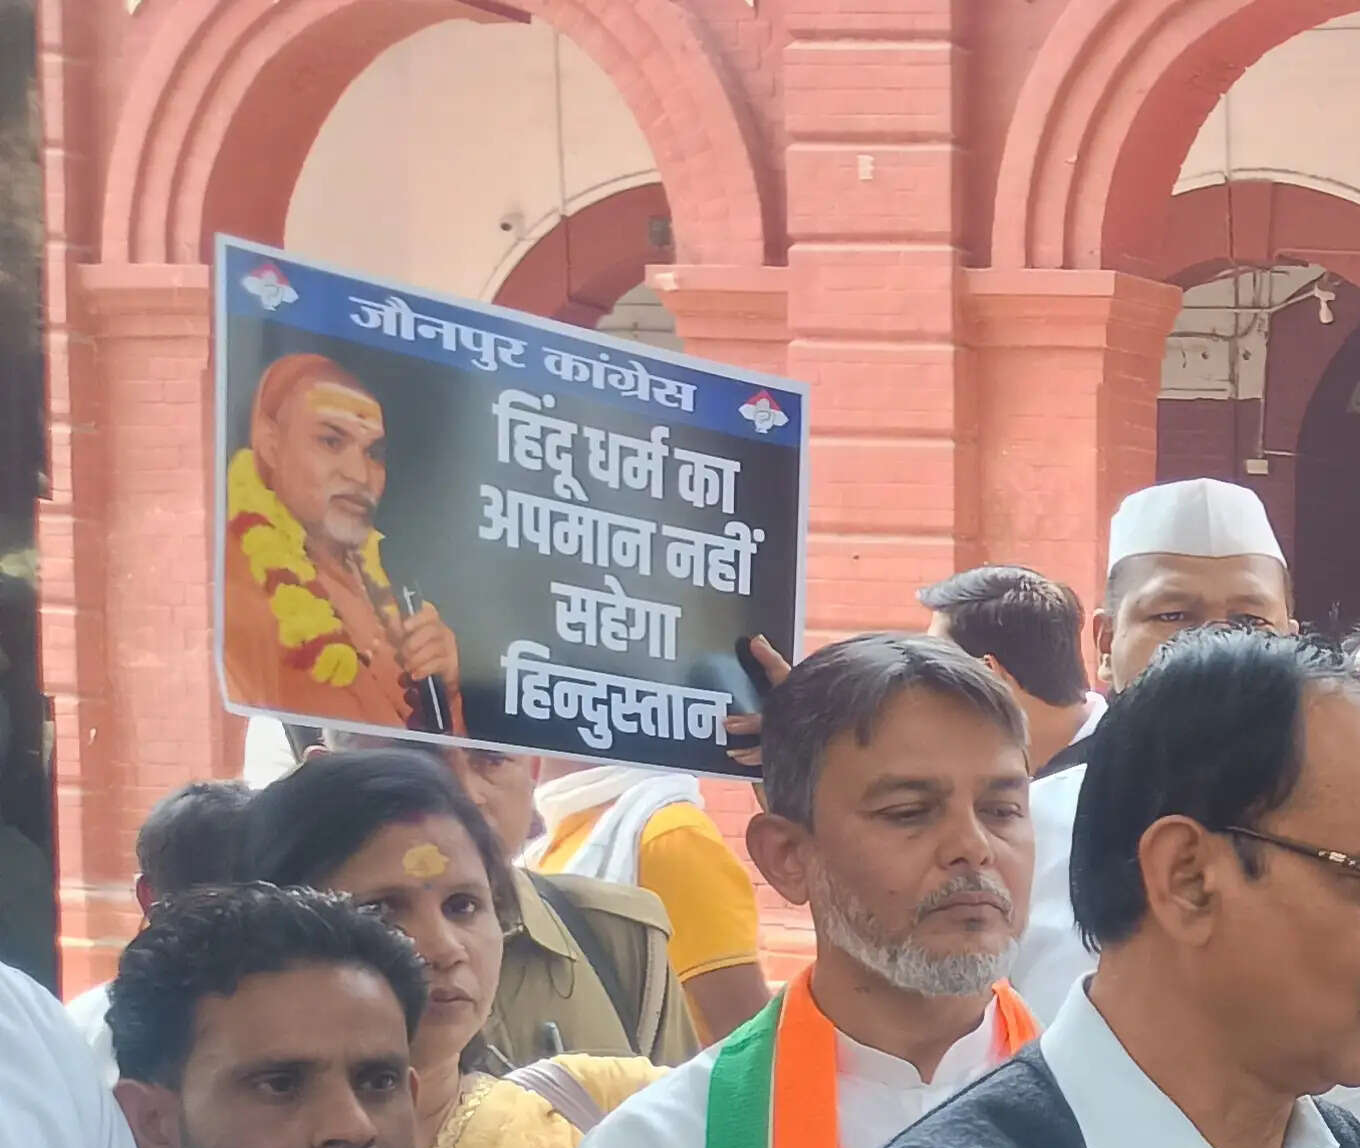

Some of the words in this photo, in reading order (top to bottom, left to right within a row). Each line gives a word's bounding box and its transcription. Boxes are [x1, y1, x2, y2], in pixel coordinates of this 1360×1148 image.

[349, 295, 528, 371] जौनपुर
[542, 346, 698, 413] कांग्रेस
[492, 389, 589, 503] हिंदू
[586, 426, 670, 499] धर्म
[672, 448, 741, 514] का
[478, 484, 659, 576] अपमान
[662, 522, 766, 595] नहीं
[551, 575, 681, 660] सहेगा
[501, 640, 732, 749] हिन्दुस्तान
